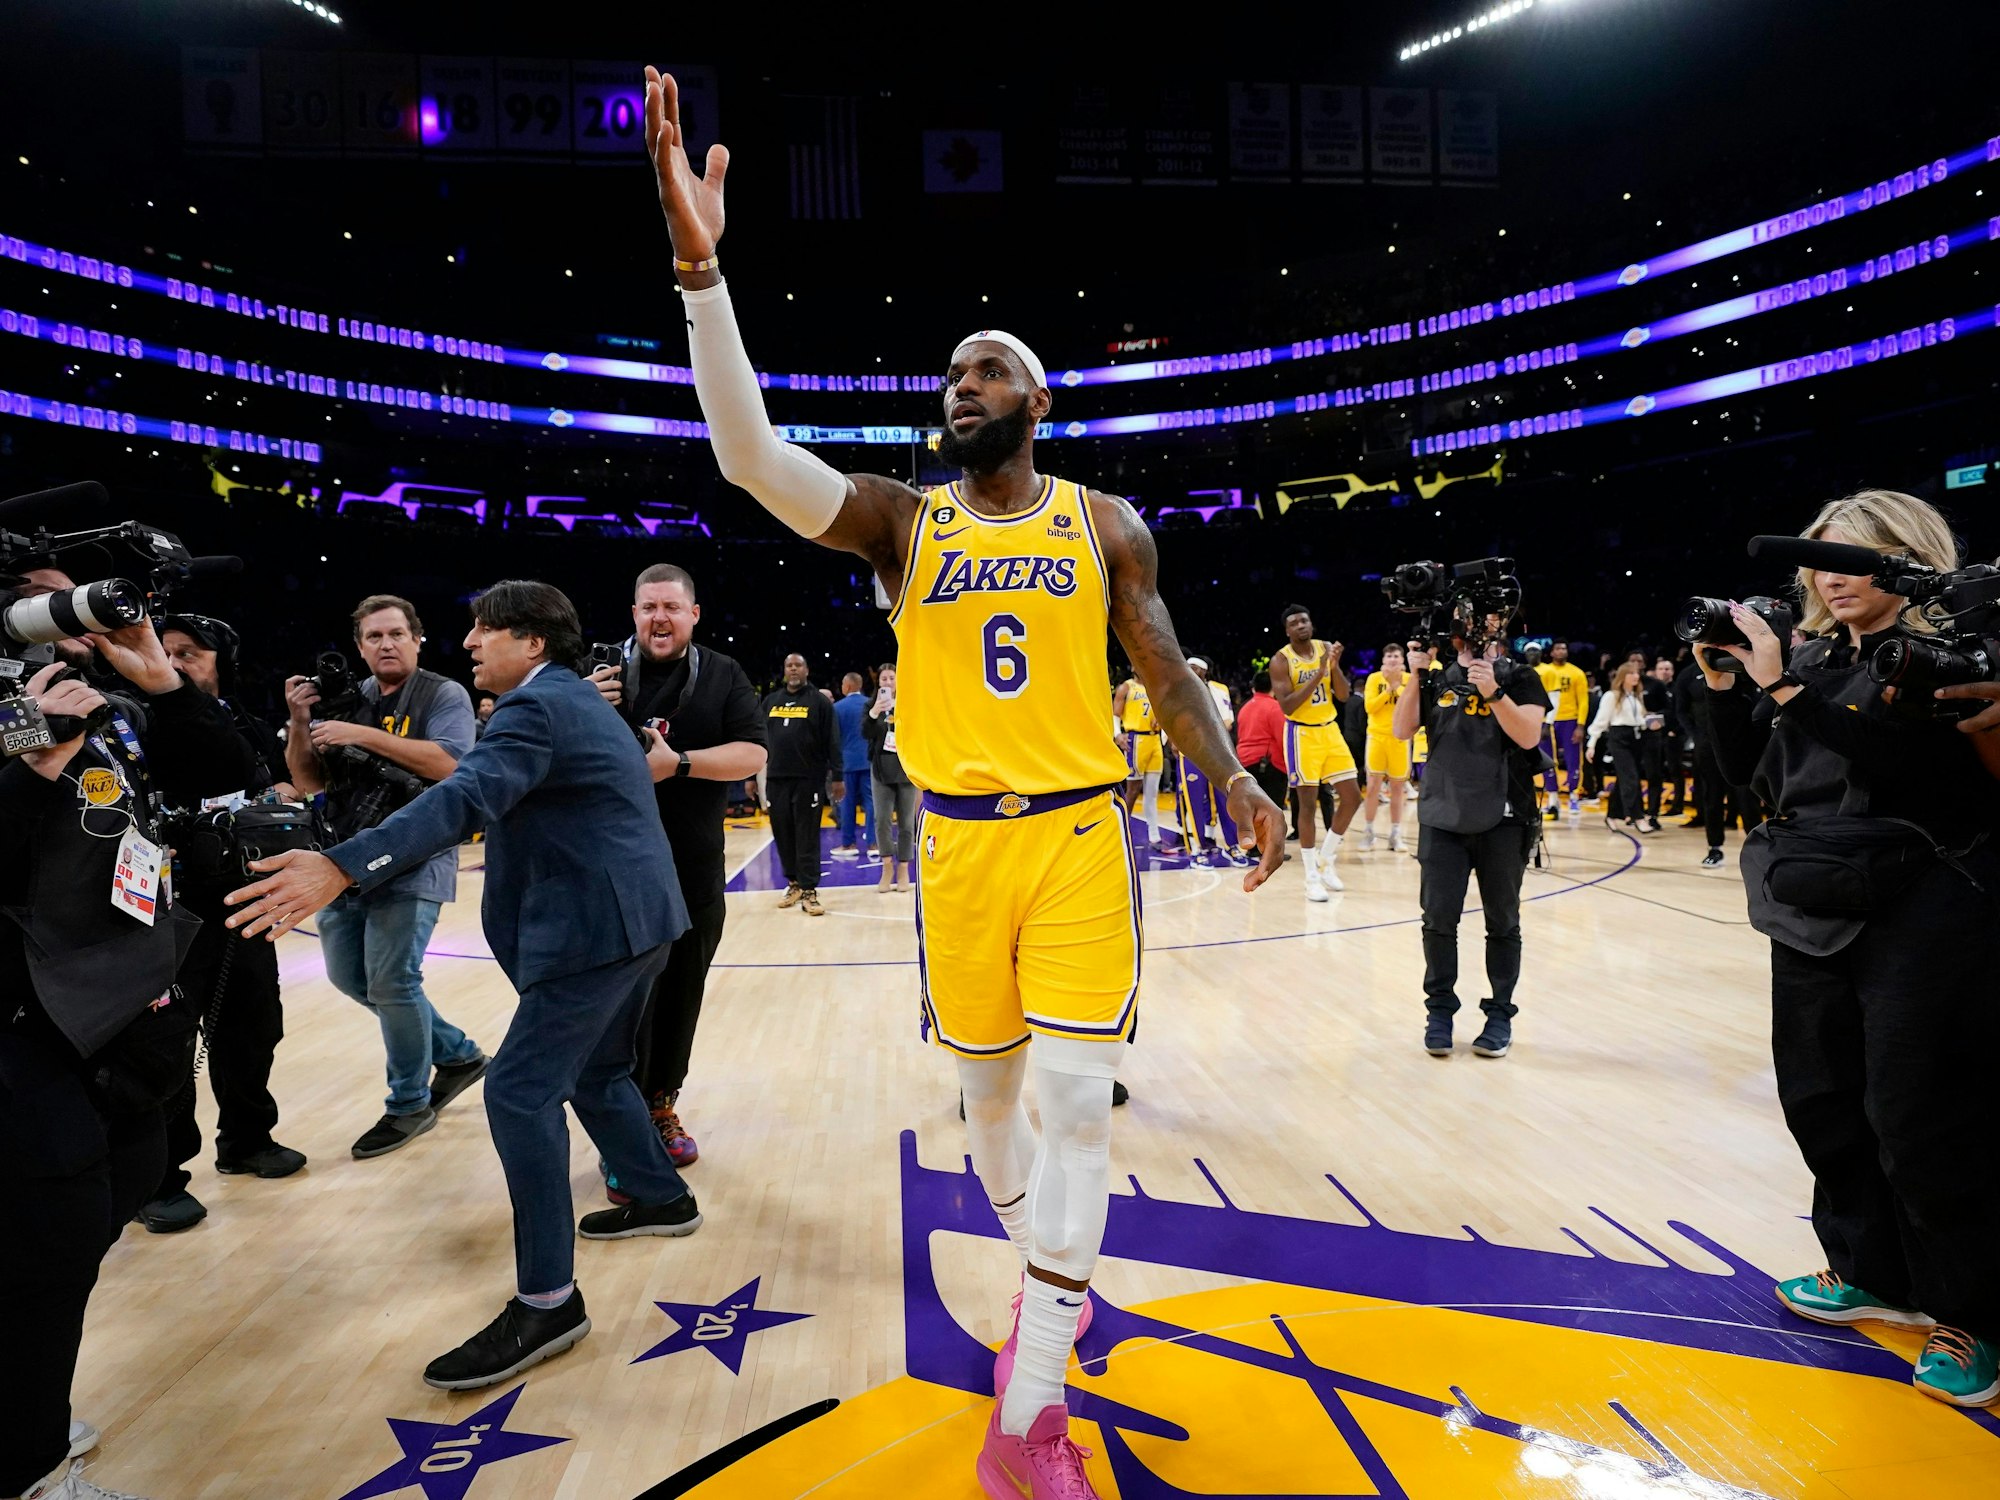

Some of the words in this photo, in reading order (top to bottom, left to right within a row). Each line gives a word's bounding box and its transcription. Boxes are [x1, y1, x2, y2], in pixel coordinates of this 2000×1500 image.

[504, 92, 562, 135] 99
[582, 96, 638, 139] 20
[1156, 158, 1204, 173] 2011-12
[1858, 158, 1948, 211] JAMES
[1860, 234, 1950, 284] JAMES
[40, 247, 133, 288] JAMES
[167, 277, 216, 308] NBA
[226, 292, 330, 334] ALL-TIME
[338, 317, 425, 350] LEADING
[1331, 321, 1412, 354] ALL-TIME
[1865, 317, 1956, 363] JAMES
[52, 323, 144, 360] JAMES
[177, 348, 225, 376] NBA
[235, 360, 338, 398] ALL-TIME
[347, 380, 432, 411] LEADING
[827, 374, 898, 392] ALL-TIME
[1334, 377, 1415, 408] ALL-TIME
[46, 400, 137, 434] JAMES
[170, 420, 219, 447] NBA
[794, 427, 811, 441] 99
[936, 508, 952, 523] 6
[1047, 527, 1081, 540] bibigo
[920, 550, 1078, 605] LAKERS
[981, 612, 1030, 700] 6
[1142, 702, 1151, 717] 7
[1311, 682, 1328, 706] 31
[1464, 694, 1491, 717] 33
[5, 729, 37, 741] SPECTRUM
[6, 731, 50, 750] SPORTS
